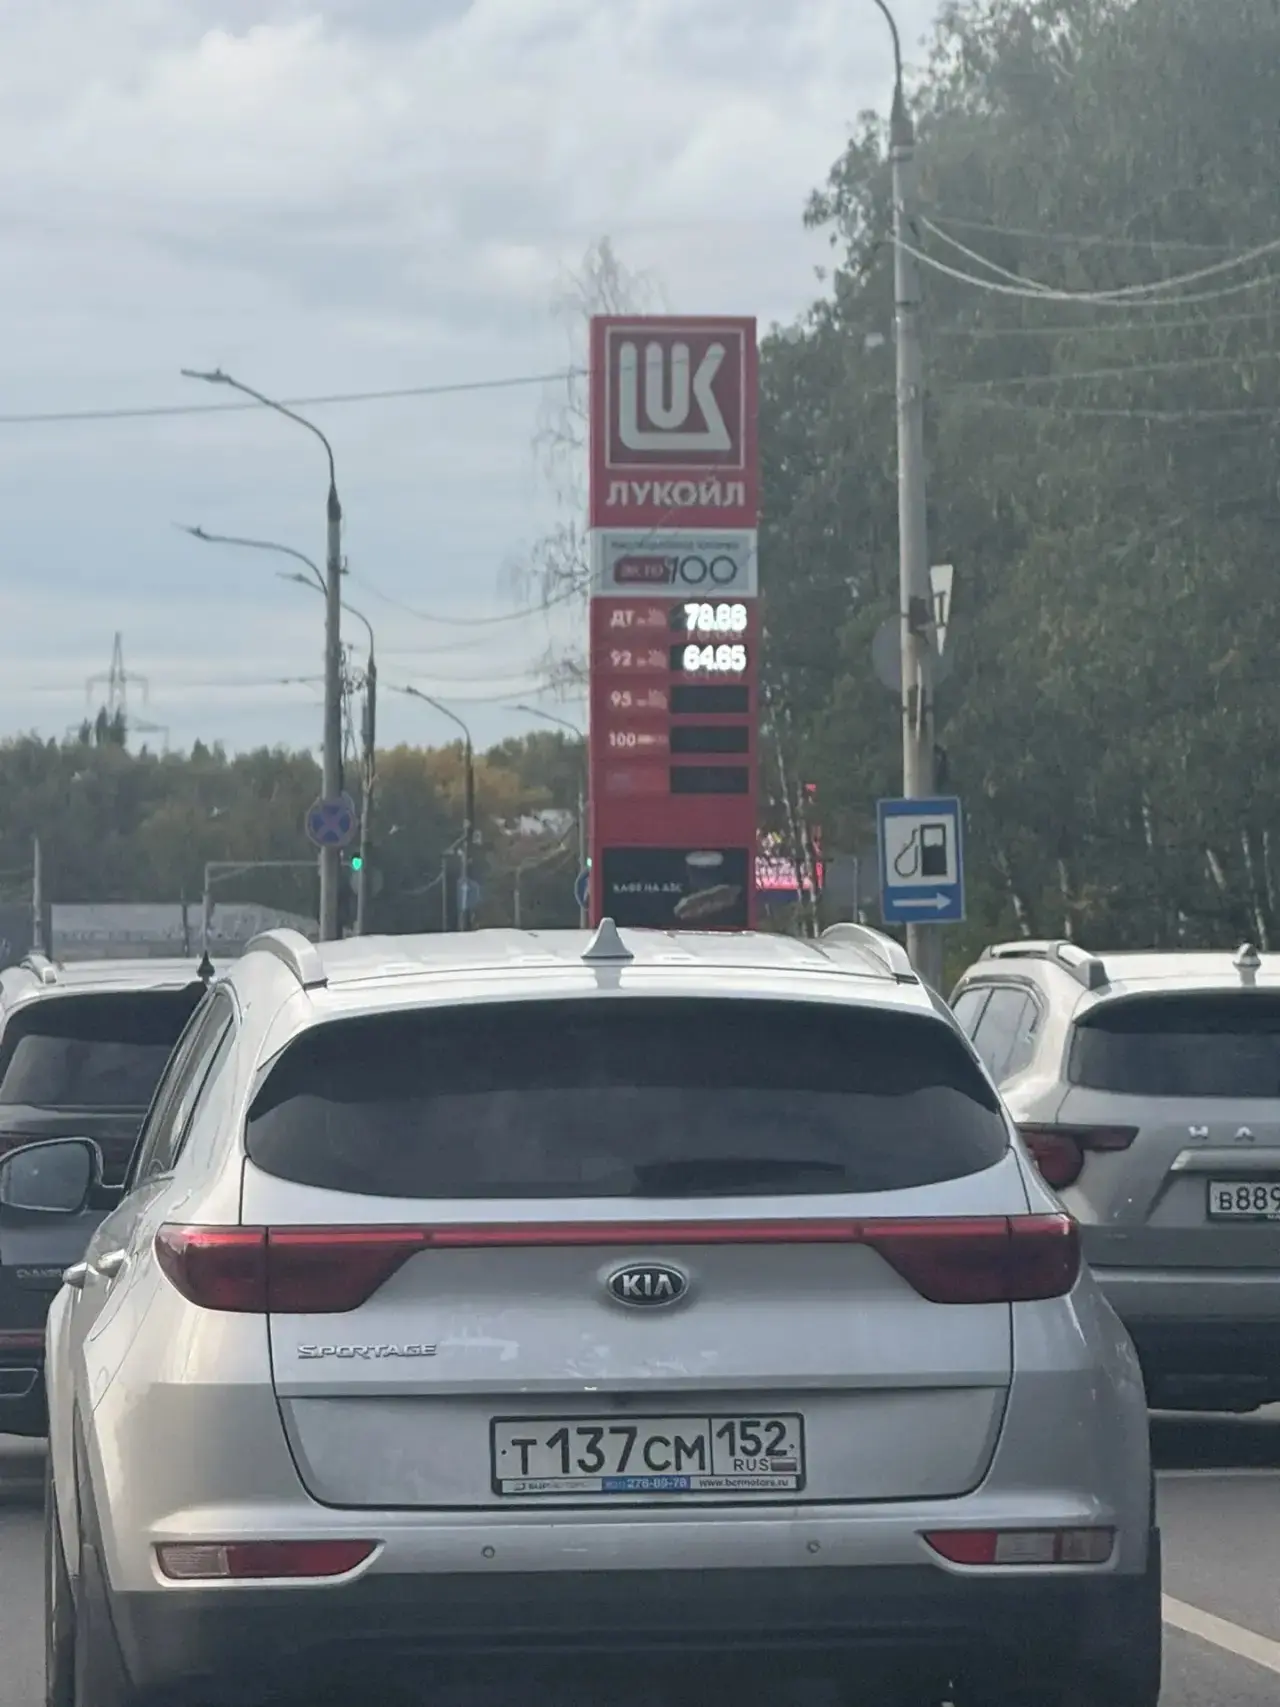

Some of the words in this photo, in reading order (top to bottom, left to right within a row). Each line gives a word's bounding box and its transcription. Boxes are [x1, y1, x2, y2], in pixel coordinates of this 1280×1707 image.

[606, 476, 745, 507] ЛУКОЙЛ
[610, 610, 634, 628] ДТ
[610, 650, 632, 667] 92
[611, 690, 632, 708] 95
[609, 731, 636, 747] 100
[623, 1274, 674, 1296] KIA
[297, 1343, 437, 1359] SPORTAGE
[716, 1420, 788, 1457] 152
[733, 1458, 769, 1472] RUS
